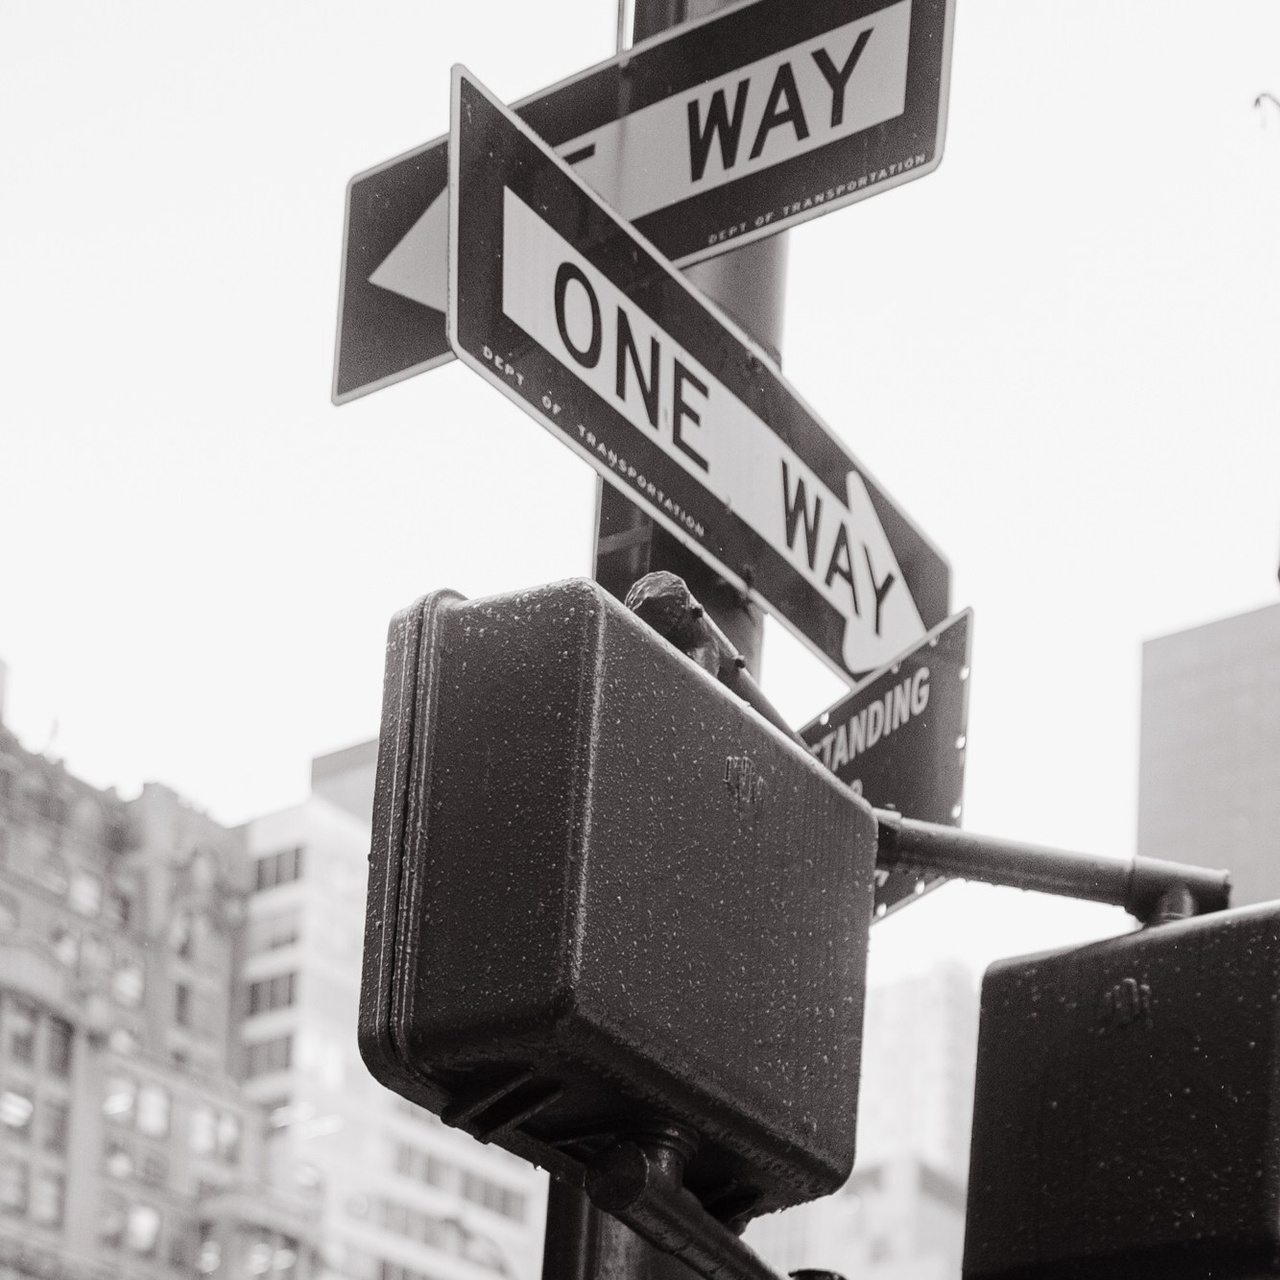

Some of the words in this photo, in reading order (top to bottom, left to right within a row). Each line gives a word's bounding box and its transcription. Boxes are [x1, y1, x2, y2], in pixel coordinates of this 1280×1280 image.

[686, 27, 874, 183] WAY
[708, 221, 747, 246] DEPT
[754, 210, 774, 227] OF
[782, 153, 926, 217] TRANSPORTATION
[482, 344, 524, 386] DEPT
[541, 394, 562, 415] OF
[577, 423, 706, 538] TRANSPORTATION
[554, 261, 710, 475] ONE
[780, 458, 897, 638] WAY
